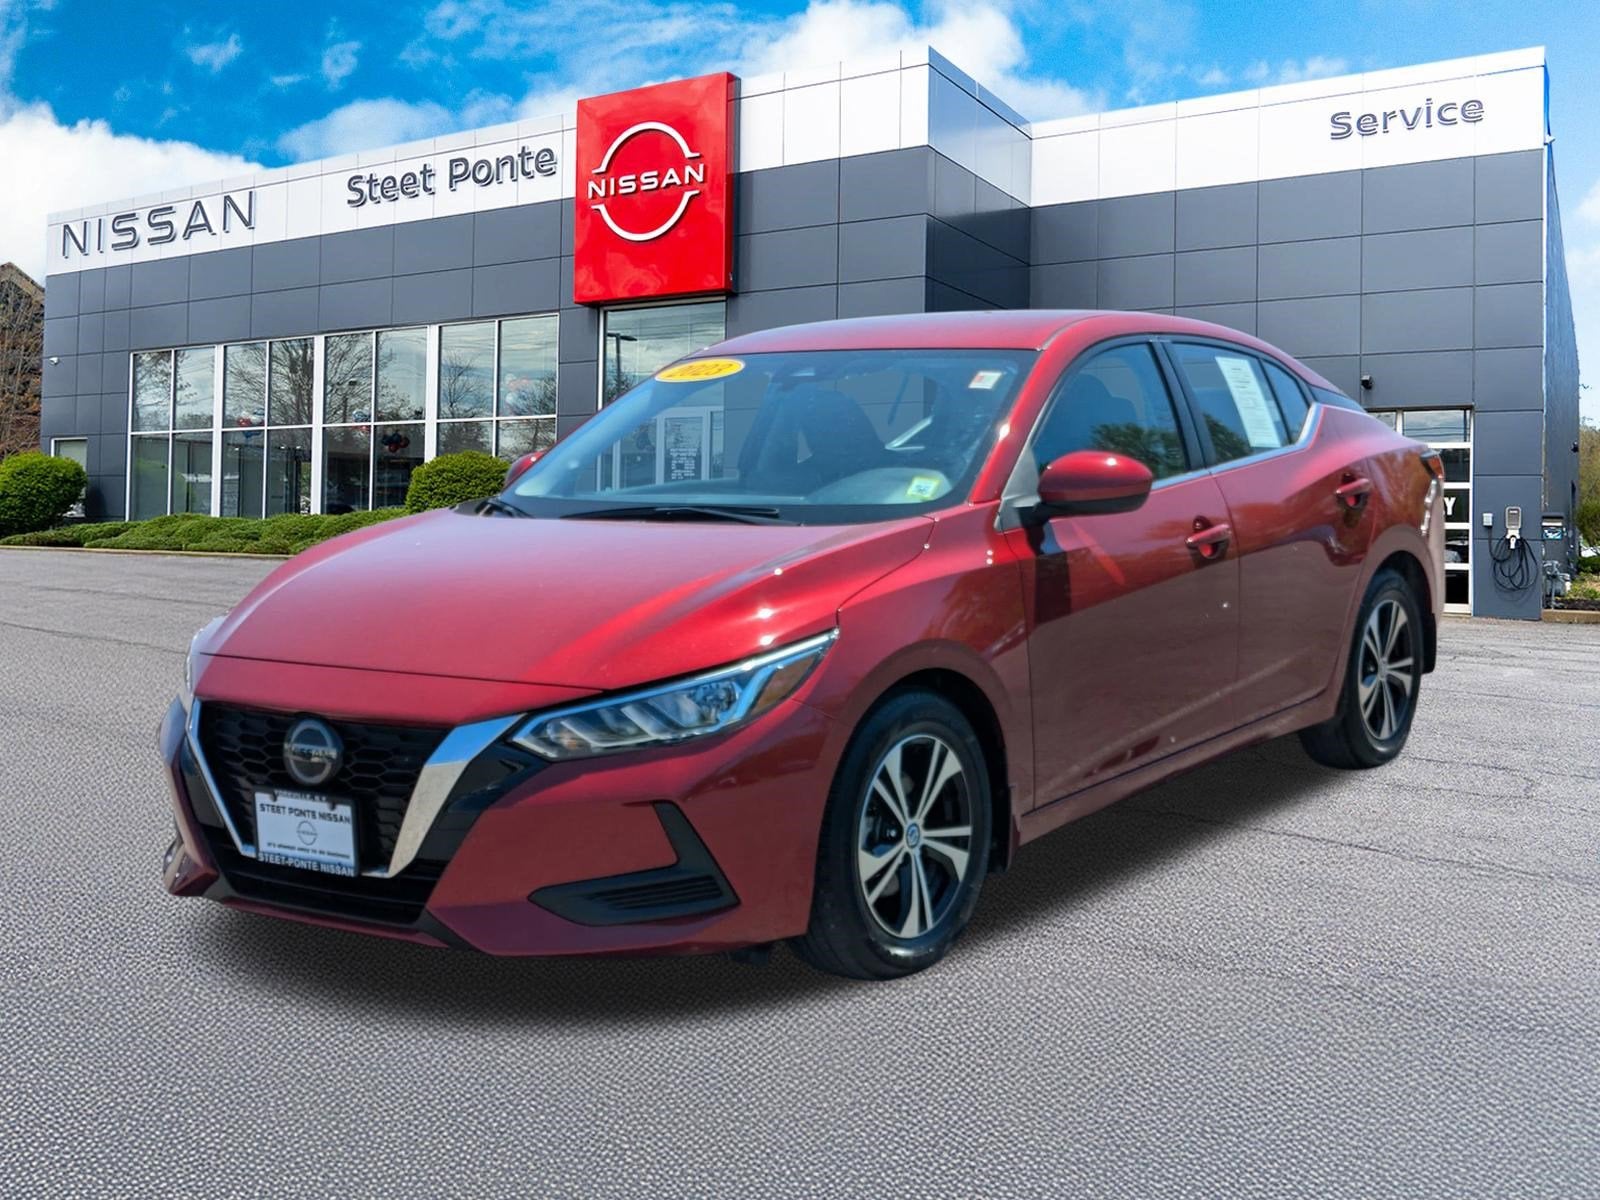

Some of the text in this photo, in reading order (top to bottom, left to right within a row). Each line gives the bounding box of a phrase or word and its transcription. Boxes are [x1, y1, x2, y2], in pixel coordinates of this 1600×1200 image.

[1330, 98, 1485, 140] Service
[347, 146, 557, 207] Steet Ponte
[587, 163, 705, 199] NISSAN
[62, 190, 255, 259] NISSAN
[259, 803, 351, 825] STEET PONTE NISSAN
[320, 863, 355, 877] NISSAN
